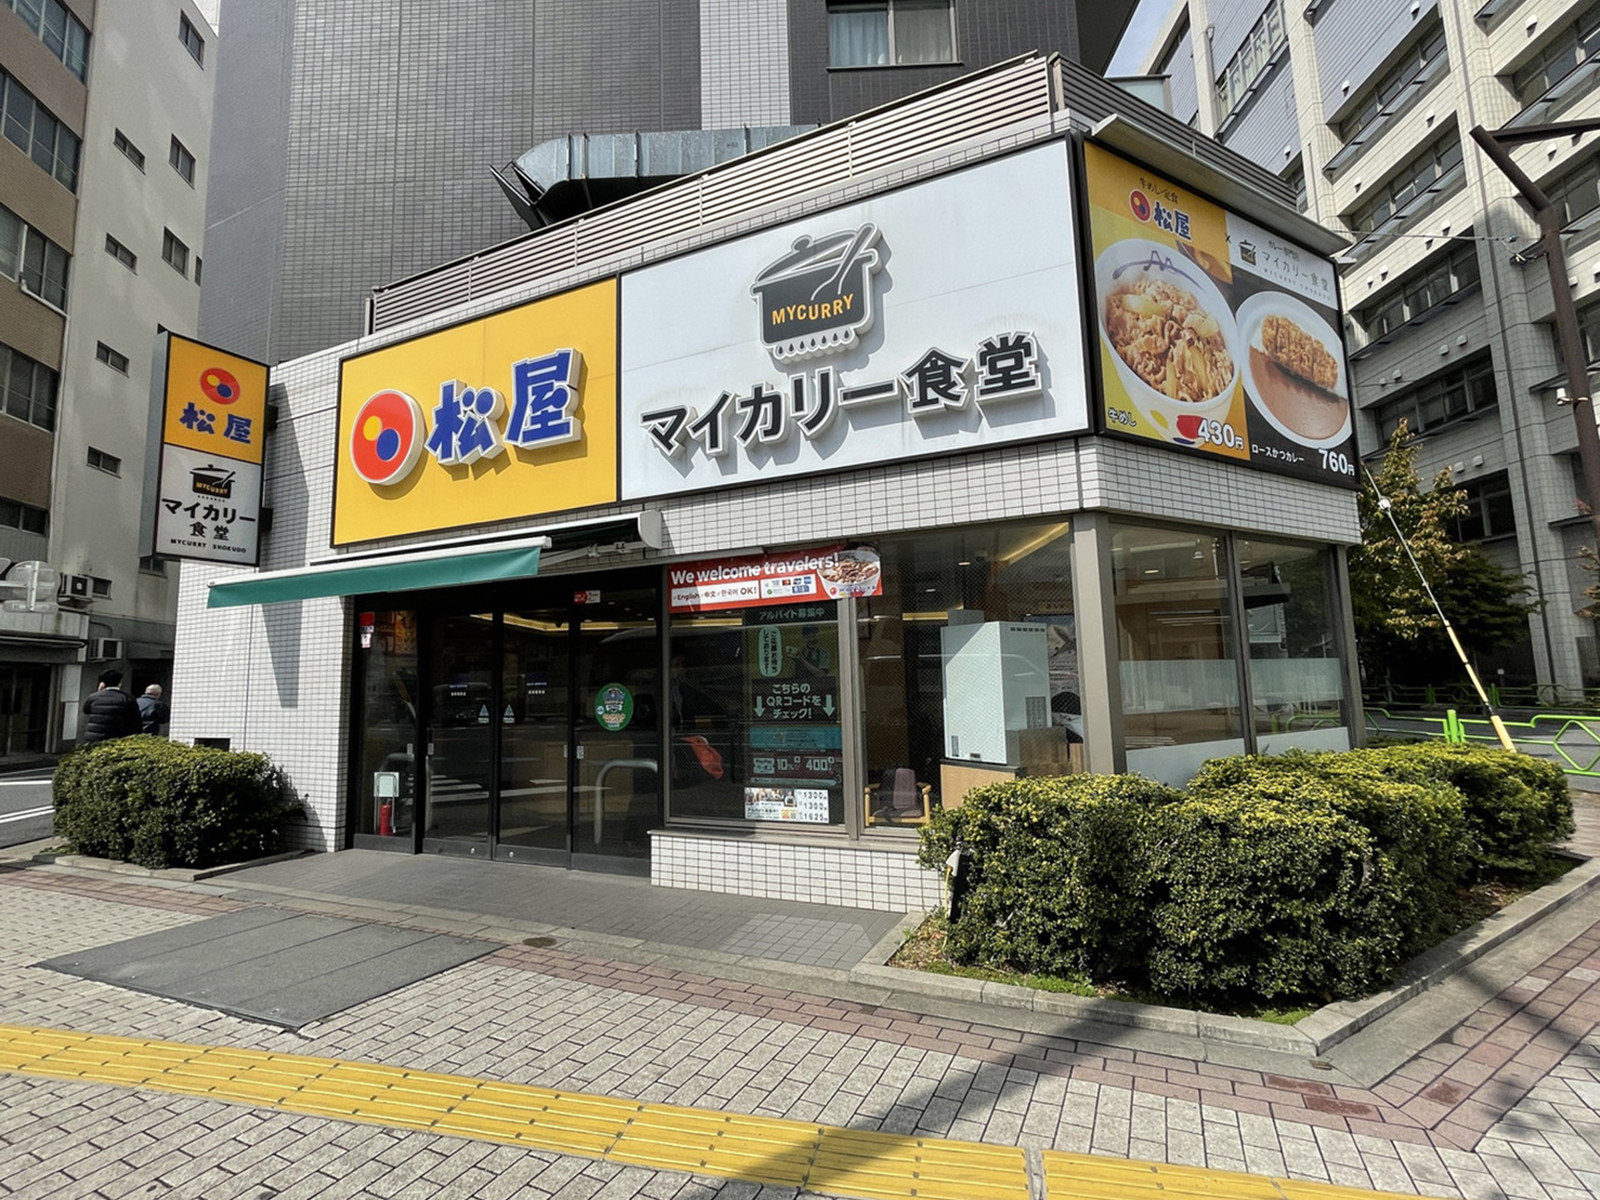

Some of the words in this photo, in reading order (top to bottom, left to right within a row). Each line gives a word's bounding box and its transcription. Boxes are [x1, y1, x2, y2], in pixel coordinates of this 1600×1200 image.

[1153, 201, 1191, 240] 松屋
[771, 294, 854, 326] MYCURRY
[640, 332, 1042, 456] マイカリー食堂
[425, 349, 575, 463] 松屋
[1107, 406, 1137, 427] 牛めし
[179, 402, 252, 444] 松屋
[1198, 418, 1244, 450] 430円
[1251, 443, 1305, 464] ロースかつカレー
[1318, 448, 1355, 476] 760円
[196, 482, 228, 494] MYCURRY
[161, 498, 256, 524] マイカリー
[189, 521, 229, 541] 食堂
[170, 538, 206, 548] MYCURRY
[212, 544, 247, 553] SHOKUDO
[671, 570, 695, 585] We
[697, 565, 761, 582] welcome
[764, 552, 839, 573] travelers!
[677, 592, 699, 601] English
[740, 586, 757, 595] OK!
[772, 683, 811, 694] こちらの
[766, 695, 822, 706] QRコードを
[772, 708, 813, 719] チェック!
